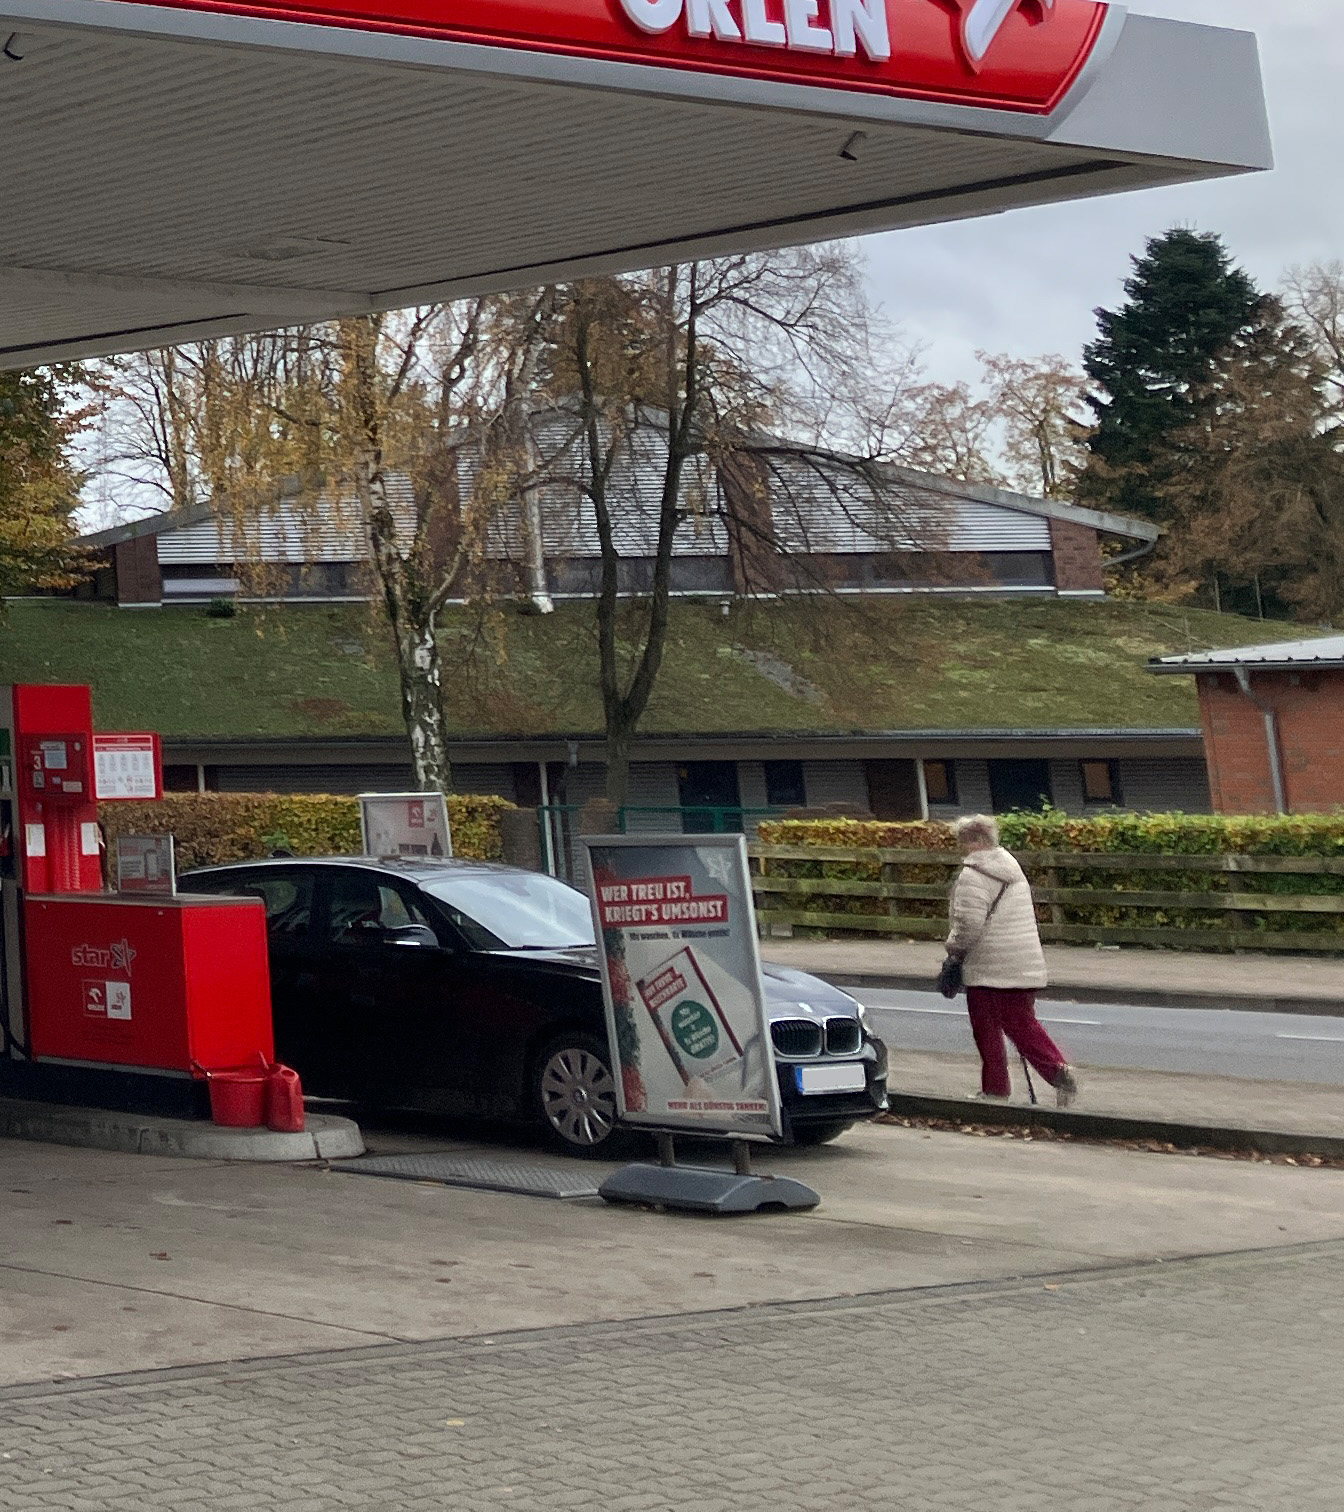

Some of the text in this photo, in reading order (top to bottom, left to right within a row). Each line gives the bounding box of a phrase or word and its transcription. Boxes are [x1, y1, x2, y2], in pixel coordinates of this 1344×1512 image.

[600, 881, 690, 902] WER TREU IST,
[604, 900, 724, 923] KRIEGT'S UMSONST
[72, 943, 110, 967] star
